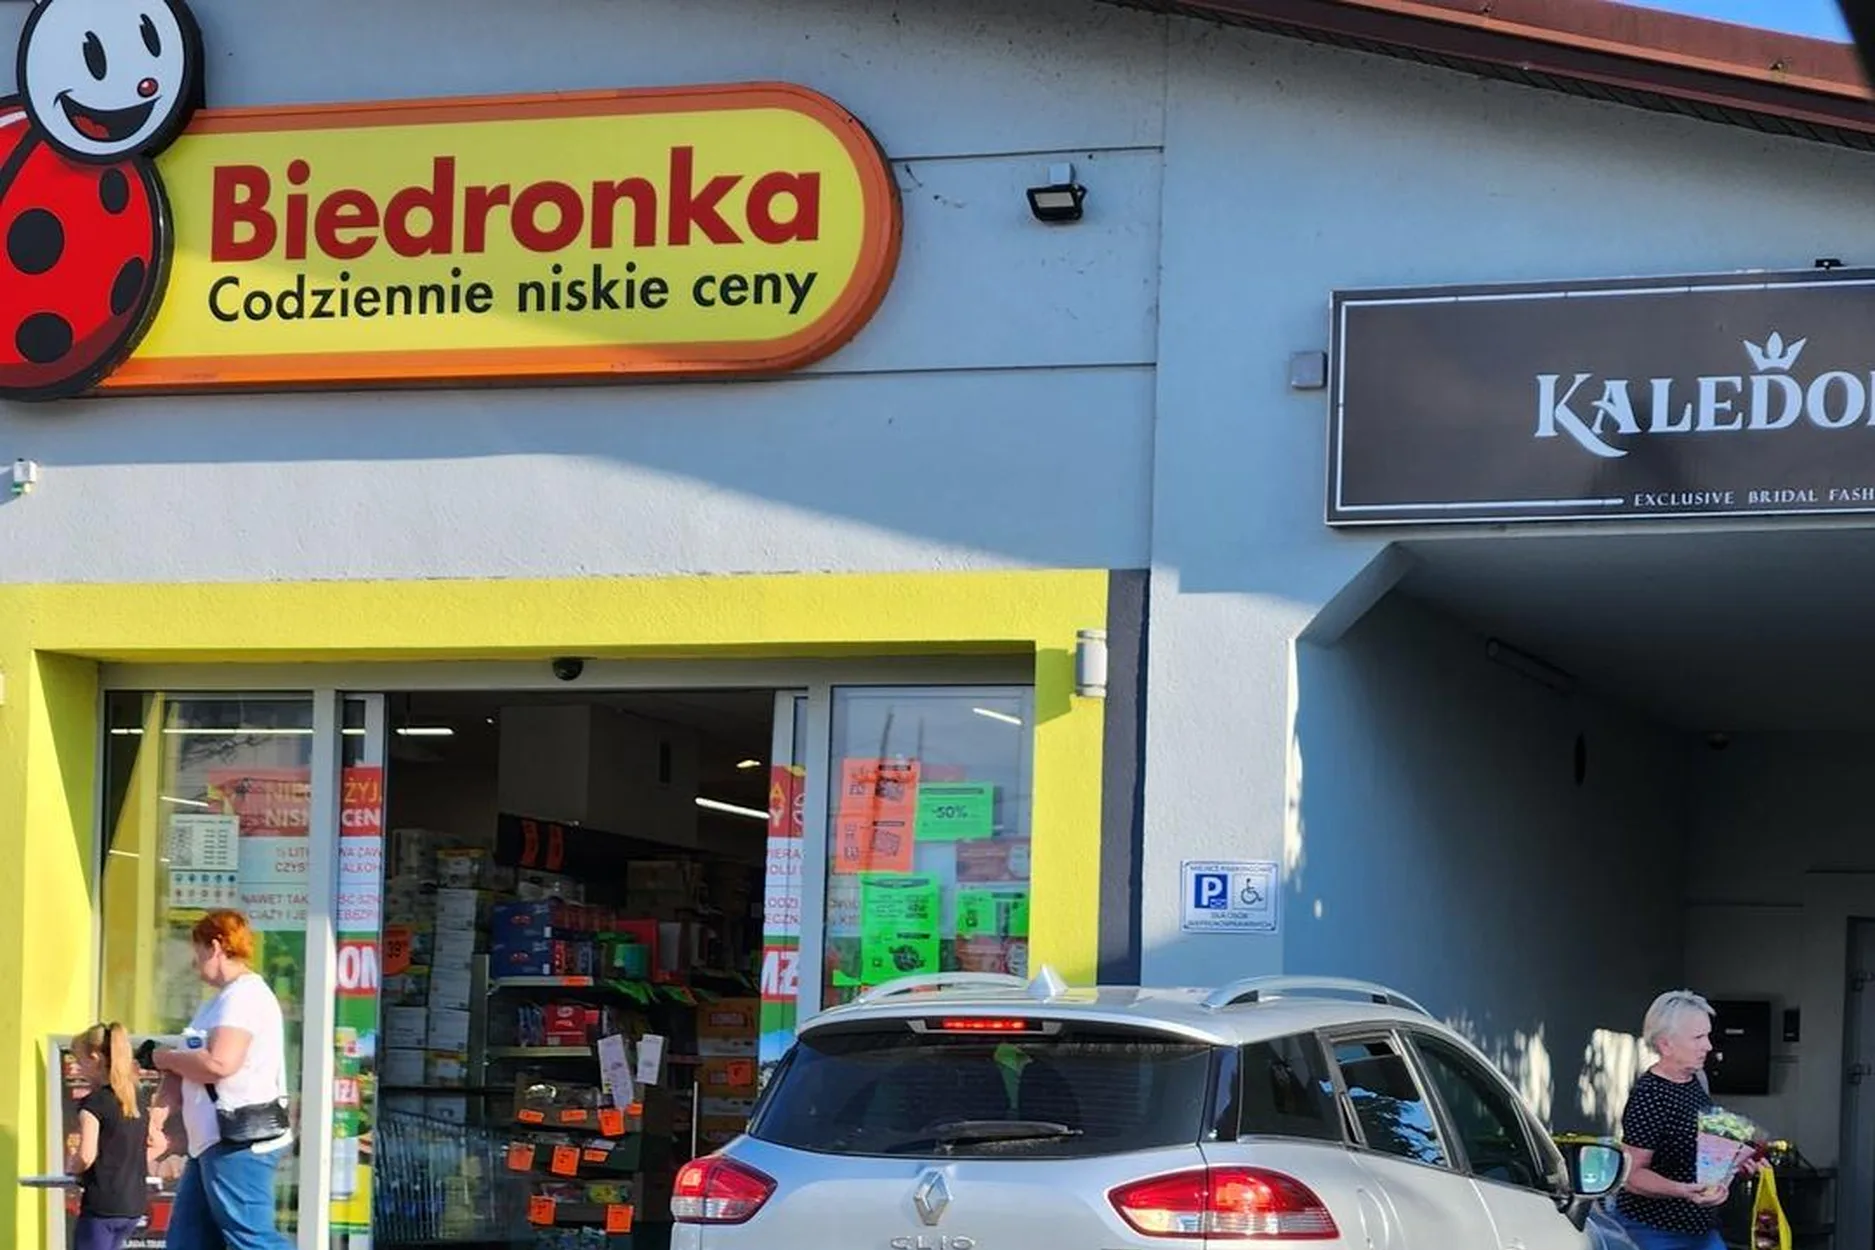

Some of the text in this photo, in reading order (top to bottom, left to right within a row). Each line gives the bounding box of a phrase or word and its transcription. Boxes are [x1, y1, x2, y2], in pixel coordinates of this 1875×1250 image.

[211, 146, 820, 262] Biedronka
[209, 261, 818, 322] Codziennie niskie ceny
[1534, 371, 1875, 457] KALEDO
[1634, 487, 1875, 507] EXCLUSIVE BRIDAL FASH
